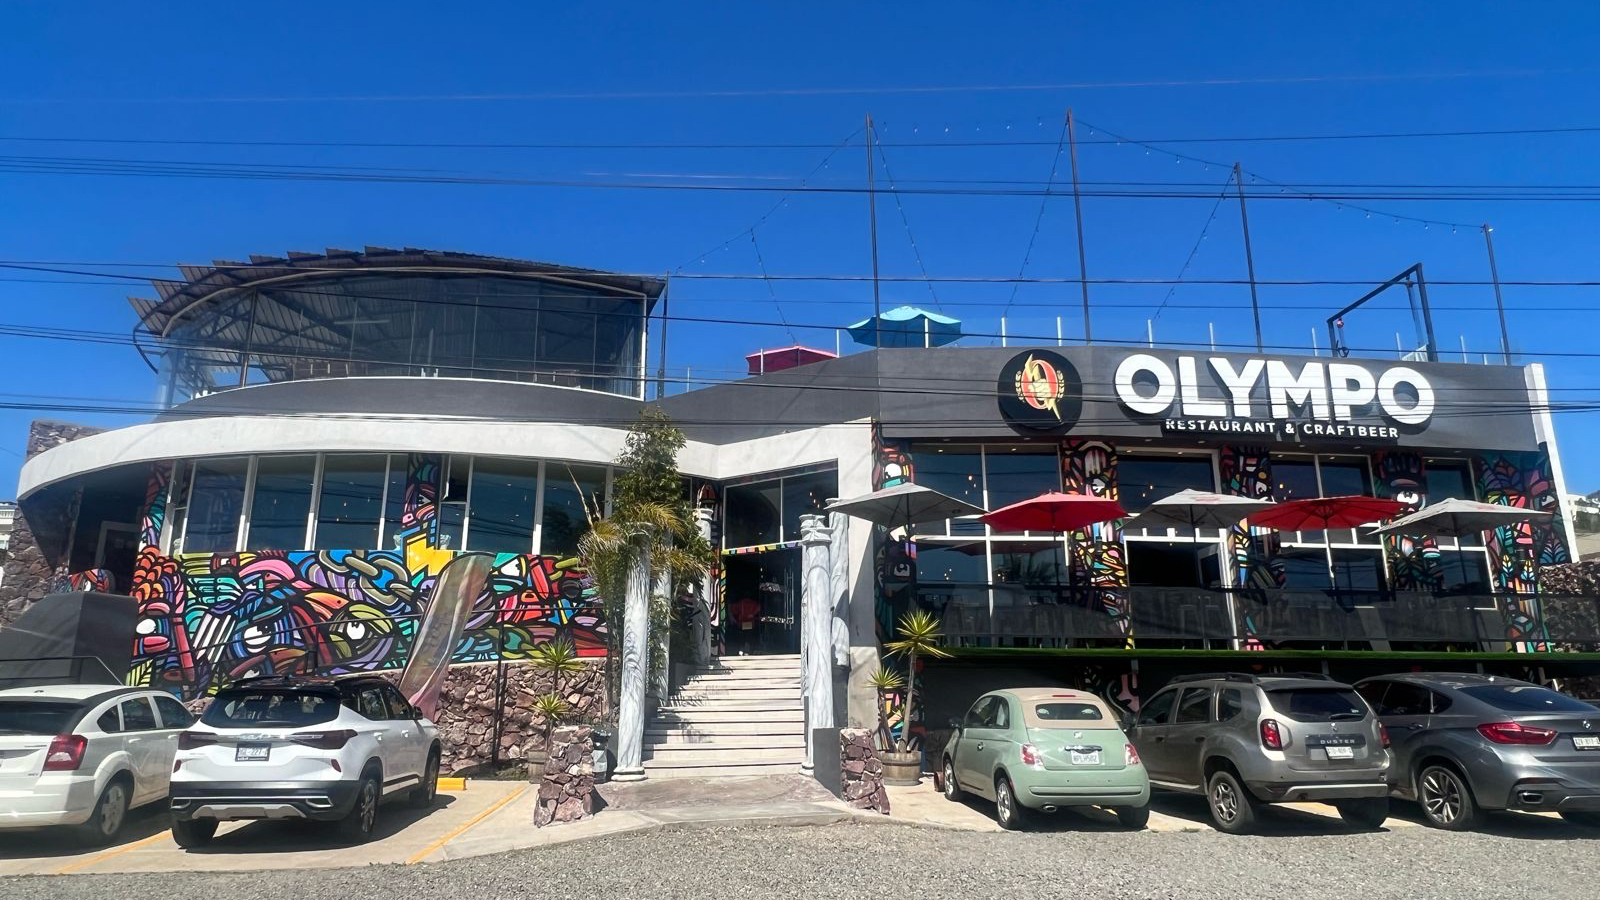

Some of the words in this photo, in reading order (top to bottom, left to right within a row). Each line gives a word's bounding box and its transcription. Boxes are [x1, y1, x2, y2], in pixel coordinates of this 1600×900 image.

[1114, 353, 1435, 424] OLYMPO
[1165, 418, 1276, 433] RESTAURANT
[1285, 423, 1295, 434] &
[1303, 423, 1398, 438] CRAFTBEER
